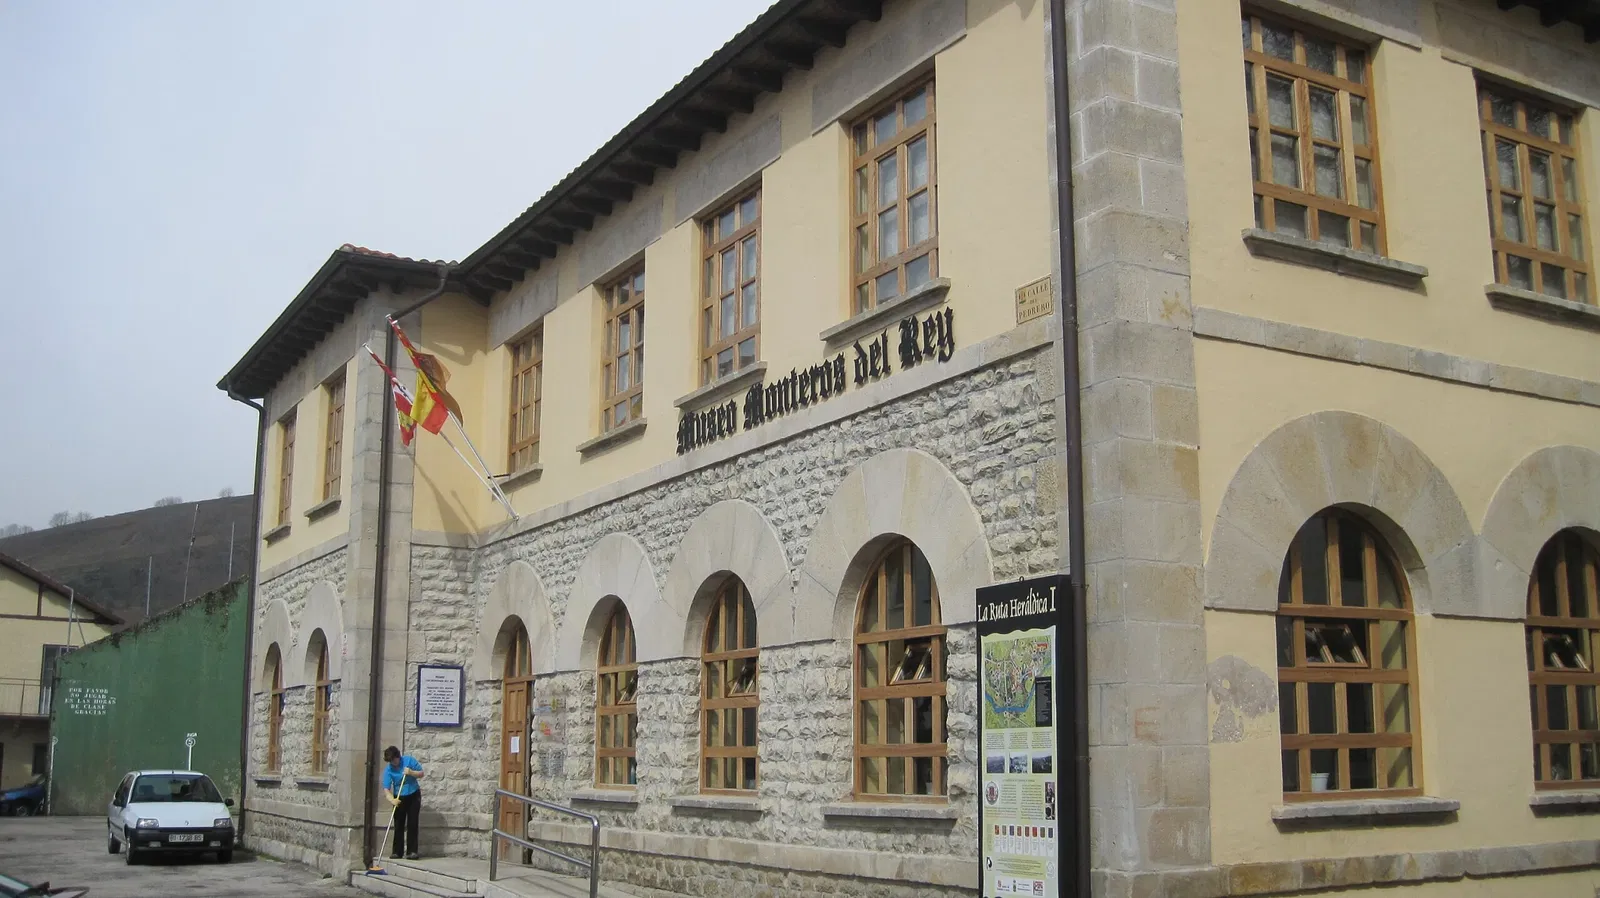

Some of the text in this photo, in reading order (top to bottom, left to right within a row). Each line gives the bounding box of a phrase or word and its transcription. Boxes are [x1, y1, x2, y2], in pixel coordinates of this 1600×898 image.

[1027, 283, 1049, 297] CALLE
[1018, 302, 1050, 320] PEDRERO
[676, 306, 956, 456] Museo Monteros del Rey
[977, 586, 1057, 623] La Ruta Heráldica I
